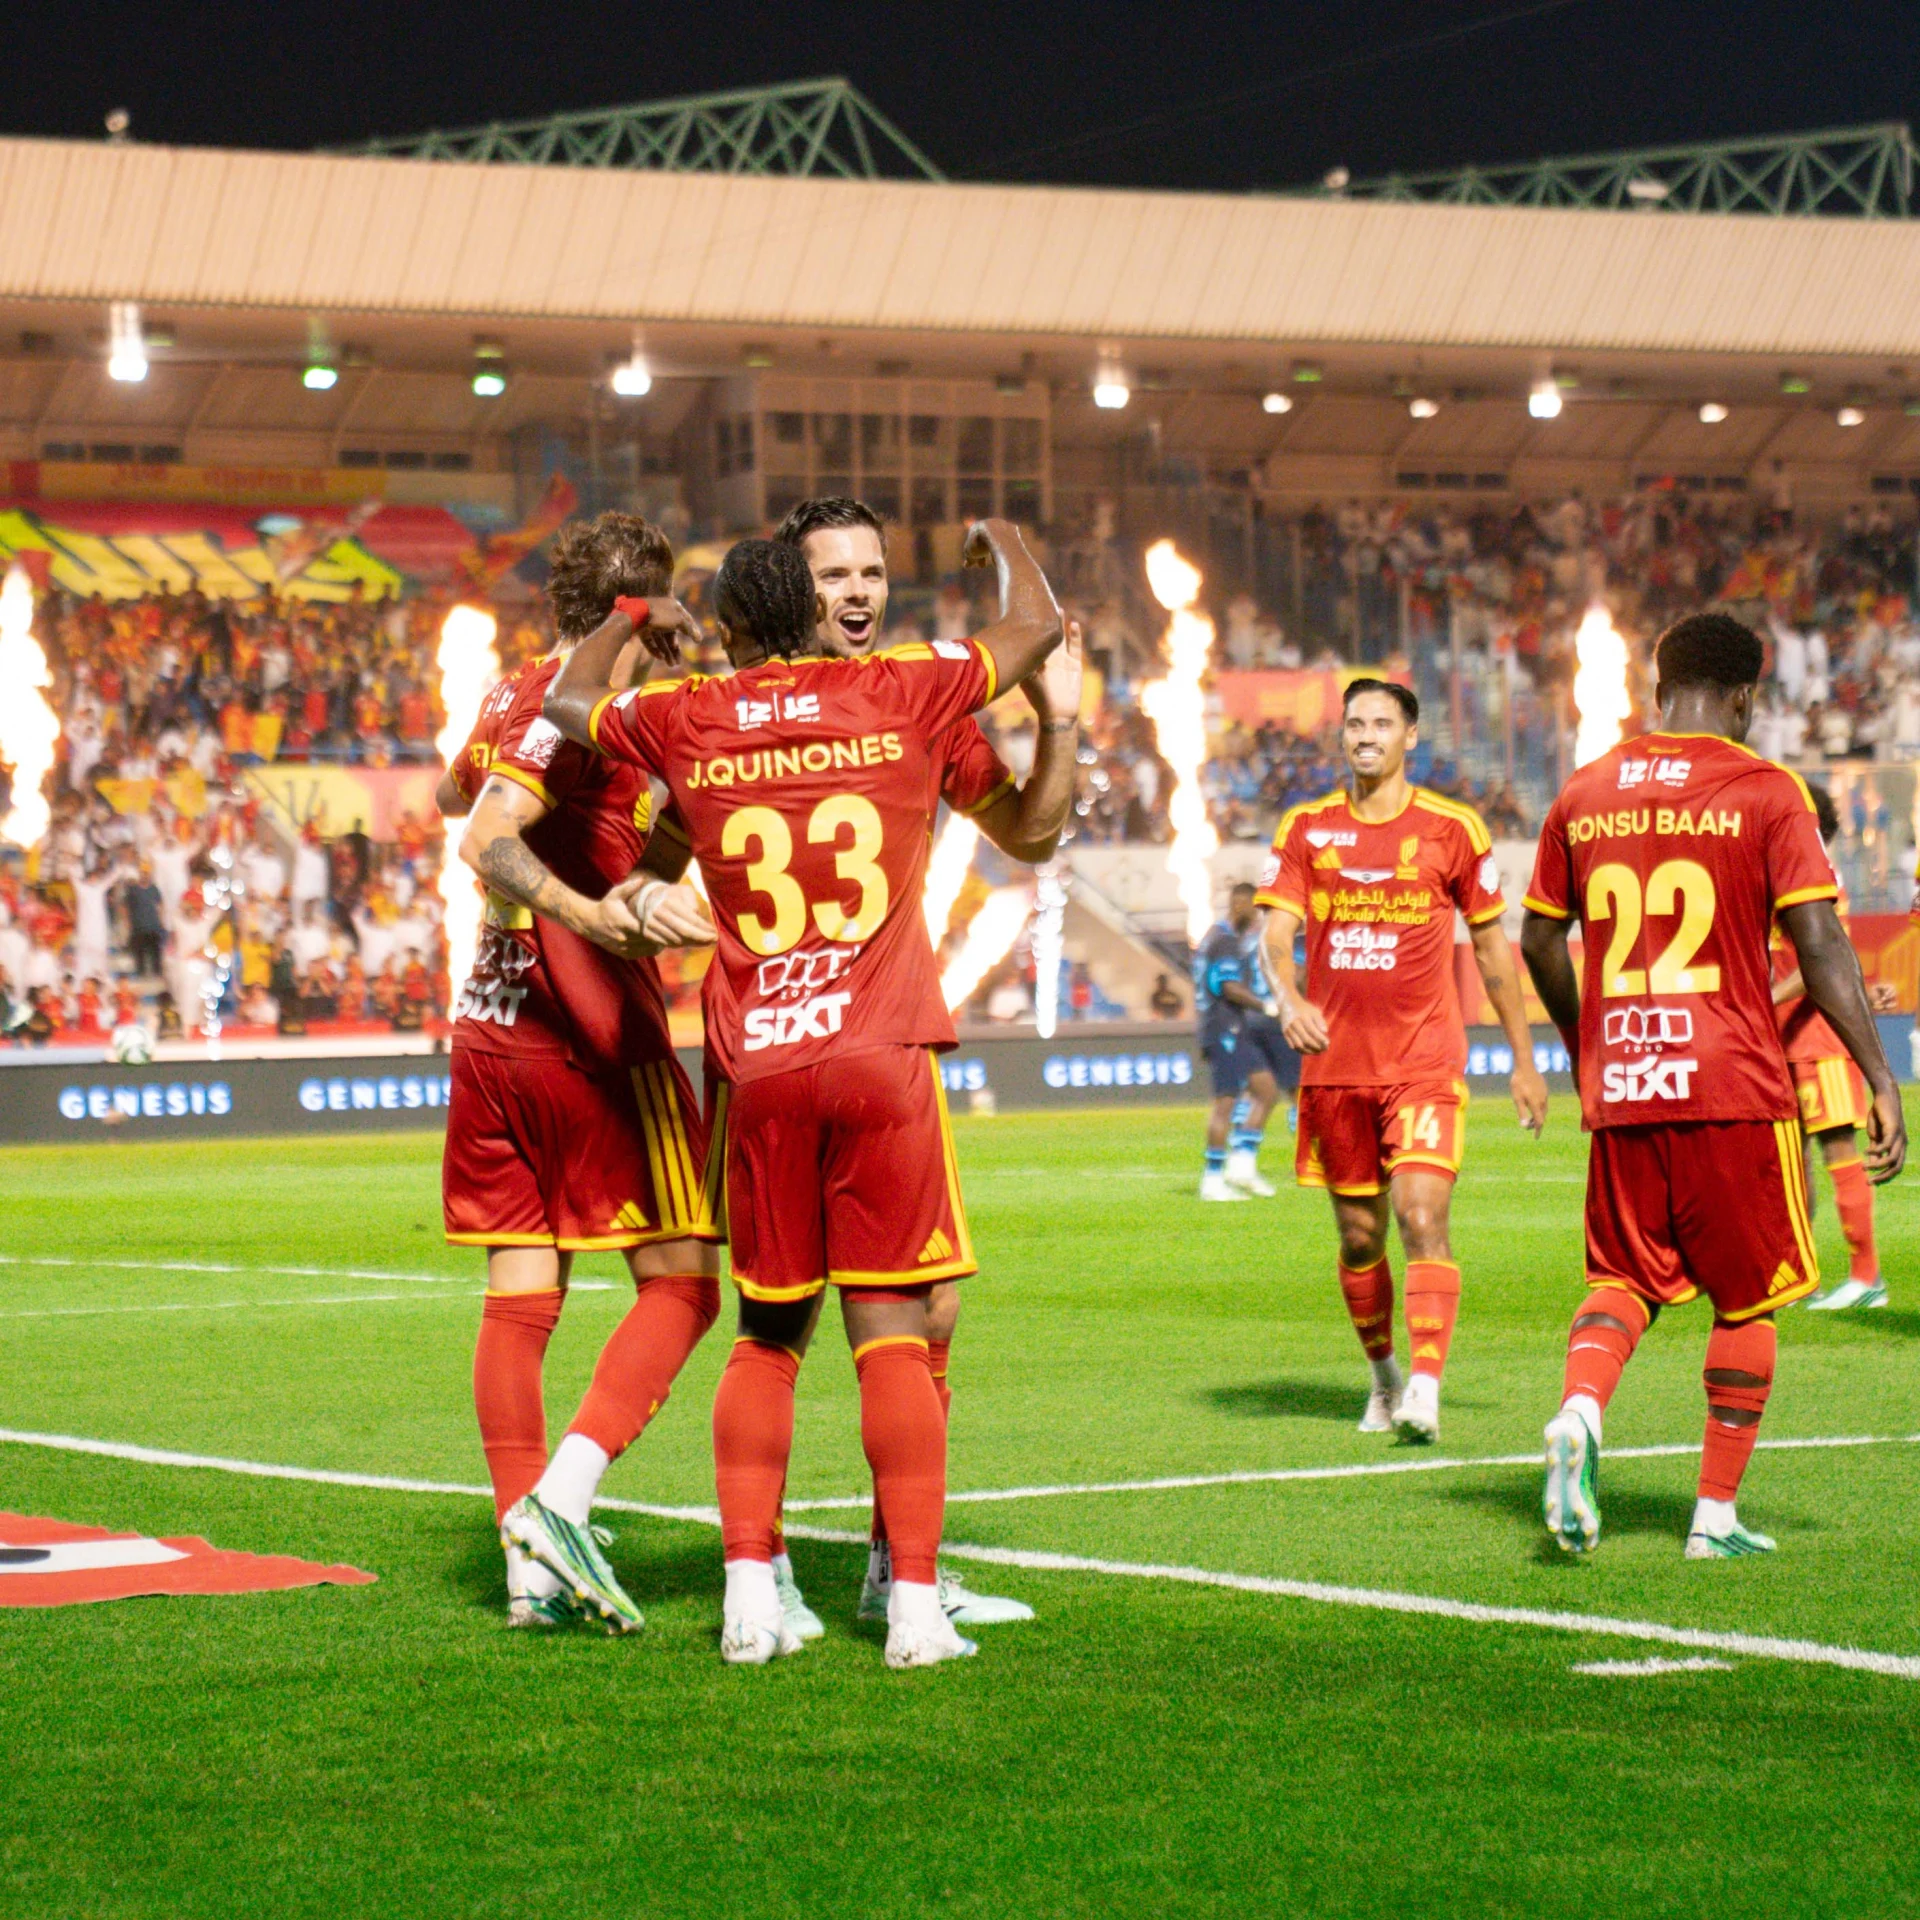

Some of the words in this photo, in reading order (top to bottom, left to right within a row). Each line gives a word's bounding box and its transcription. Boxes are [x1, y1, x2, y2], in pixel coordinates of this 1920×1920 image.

[686, 733, 903, 789] J.QUINONES
[1567, 808, 1650, 847] BONSU
[1655, 808, 1742, 838] BAAH
[721, 794, 889, 955] 33
[1332, 907, 1375, 922] Aloula
[1376, 909, 1430, 925] Aviation
[1586, 859, 1721, 998] 22
[1330, 927, 1398, 954] سراكو
[1329, 953, 1396, 970] SRACO
[744, 991, 852, 1051] SIXT
[1624, 1044, 1663, 1054] ZOHO
[1043, 1052, 1192, 1088] GENESIS
[1603, 1055, 1698, 1103] SIXT
[58, 1082, 232, 1119] GENESIS
[1398, 1105, 1441, 1151] 14
